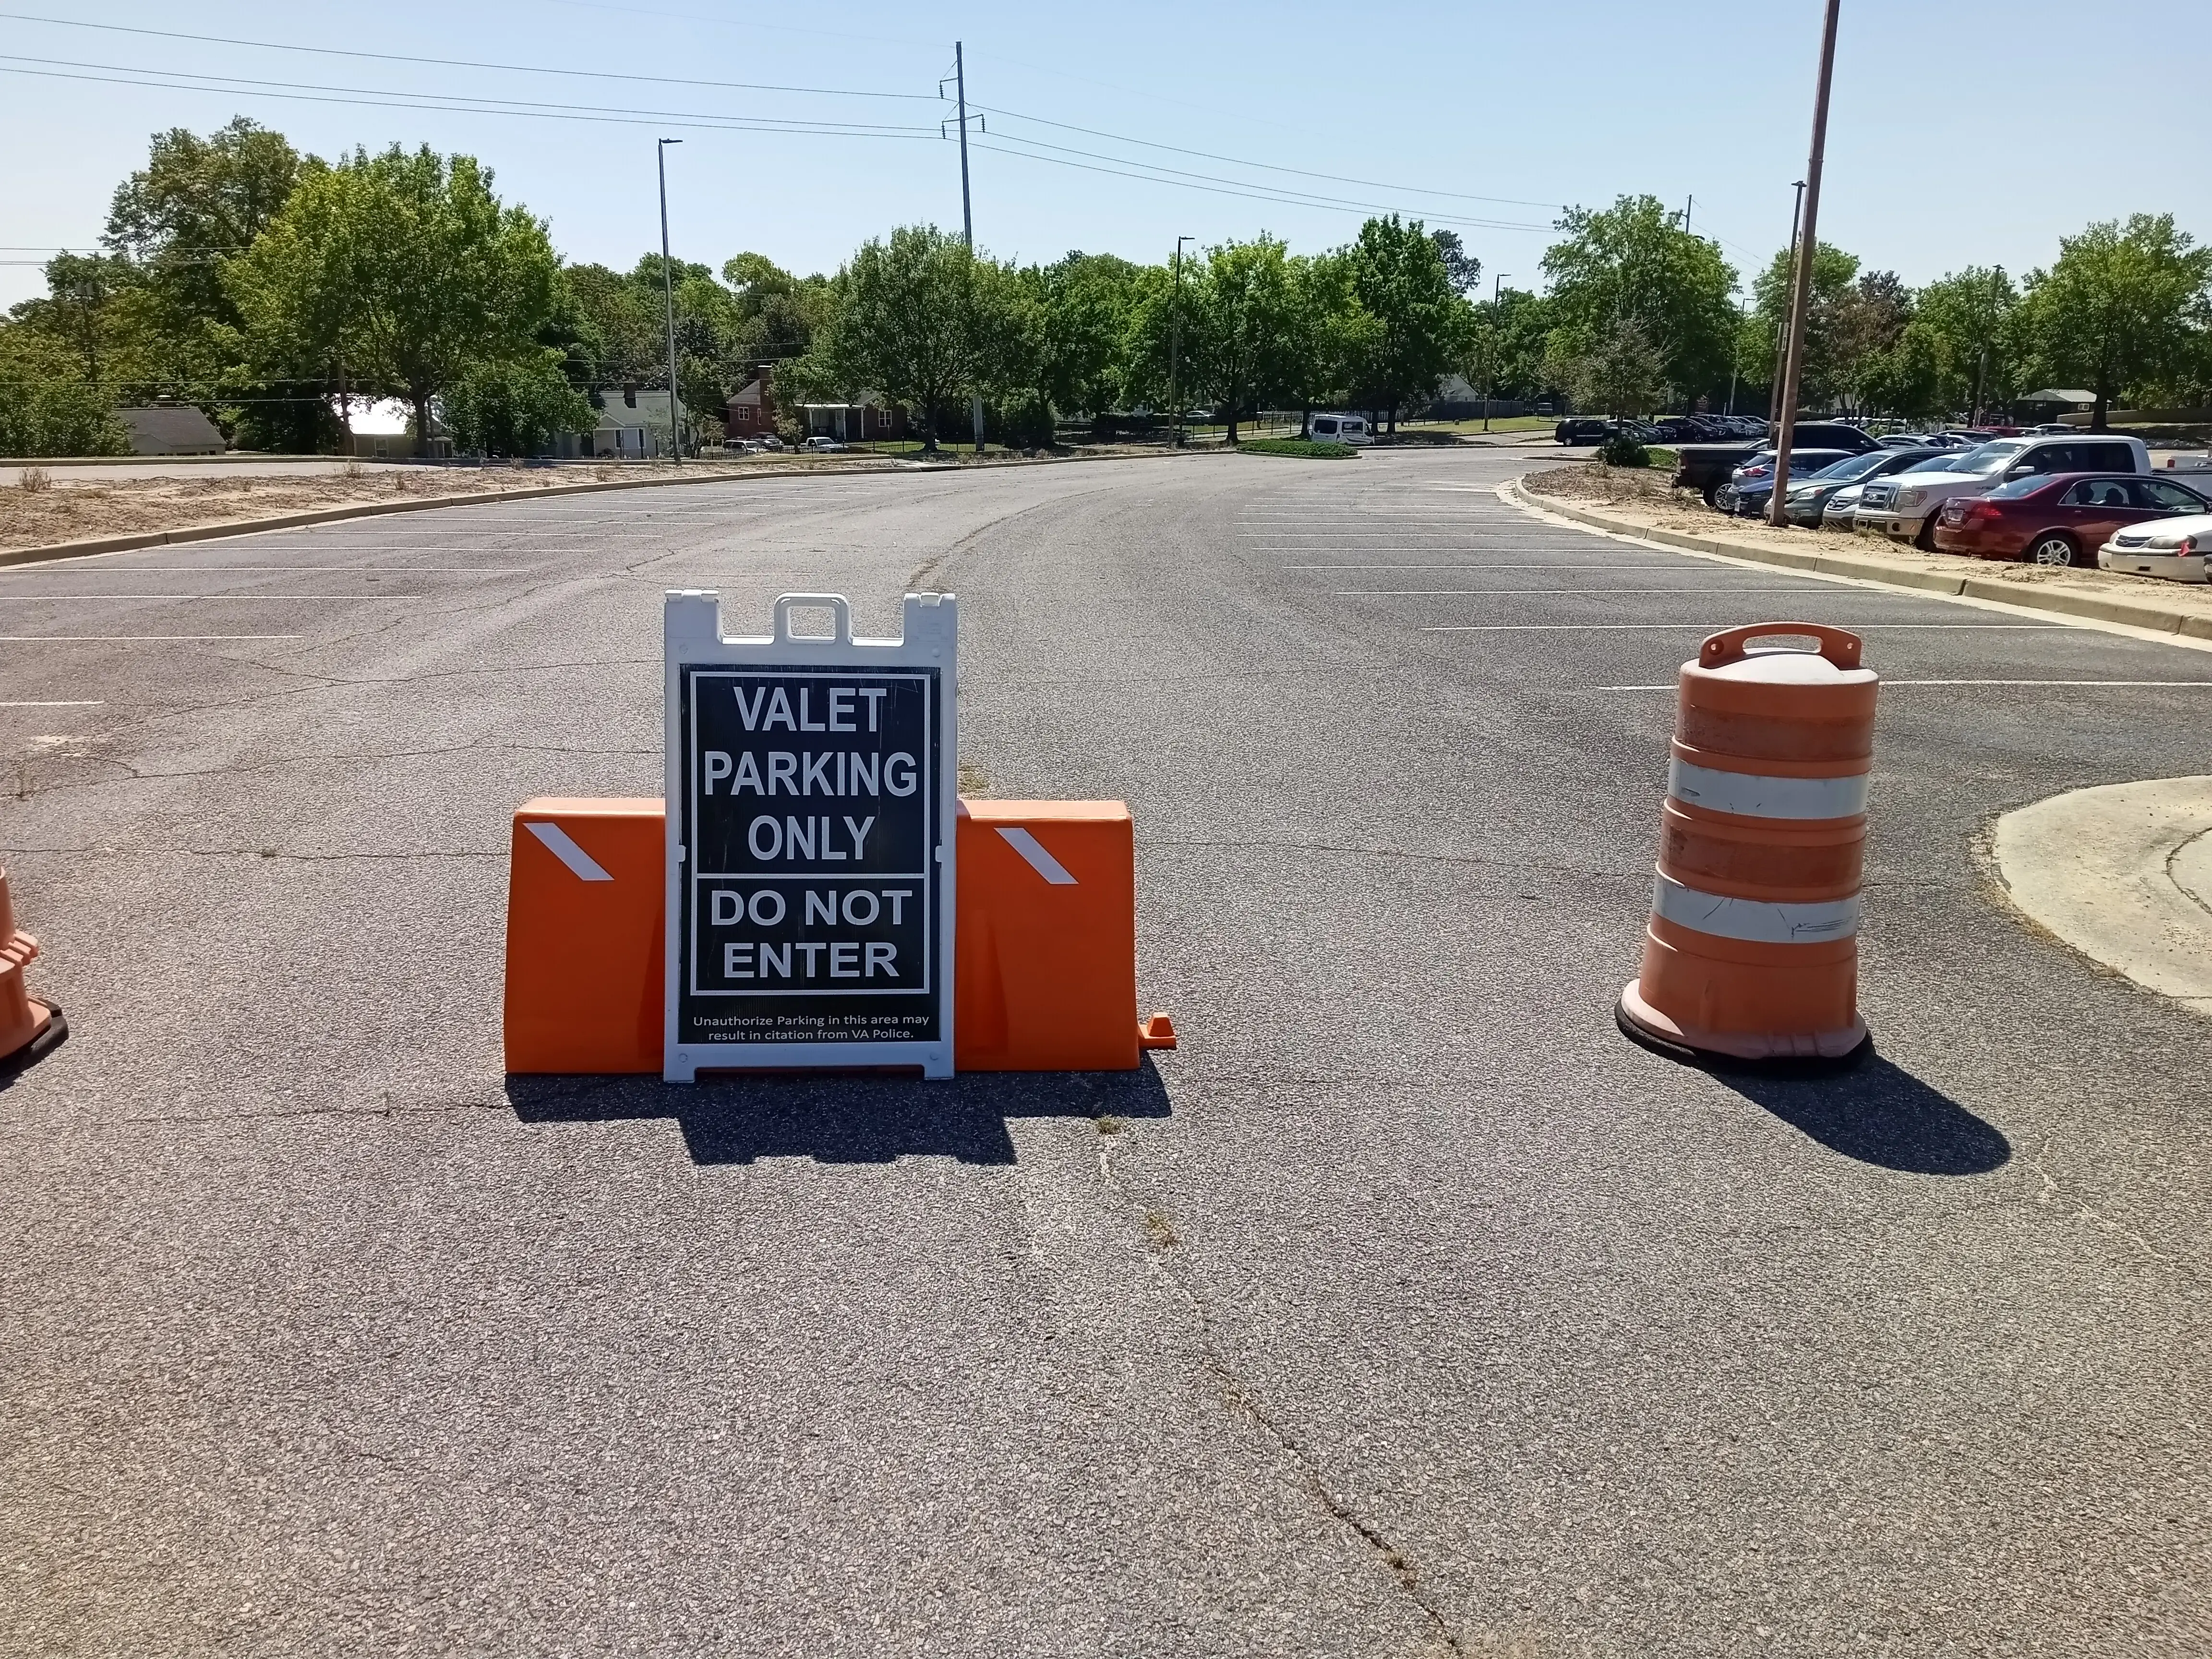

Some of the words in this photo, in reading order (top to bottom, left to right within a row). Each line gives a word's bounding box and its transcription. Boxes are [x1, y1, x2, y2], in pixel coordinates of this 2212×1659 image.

[733, 686, 887, 732] VALET
[705, 751, 917, 797] PARKING
[748, 815, 876, 861] ONLY
[711, 890, 786, 926] DO
[805, 890, 913, 926] NOT
[724, 942, 900, 978] ENTER
[693, 1016, 773, 1026] Unauthorize
[777, 1015, 825, 1027] Parking
[829, 1015, 840, 1025] in
[843, 1015, 867, 1024] this
[903, 1016, 929, 1026] may
[708, 1030, 745, 1041] result
[749, 1031, 761, 1040] in
[765, 1030, 813, 1040] citation
[817, 1029, 848, 1039] from
[852, 1029, 869, 1039] VA
[873, 1029, 914, 1039] Police.
